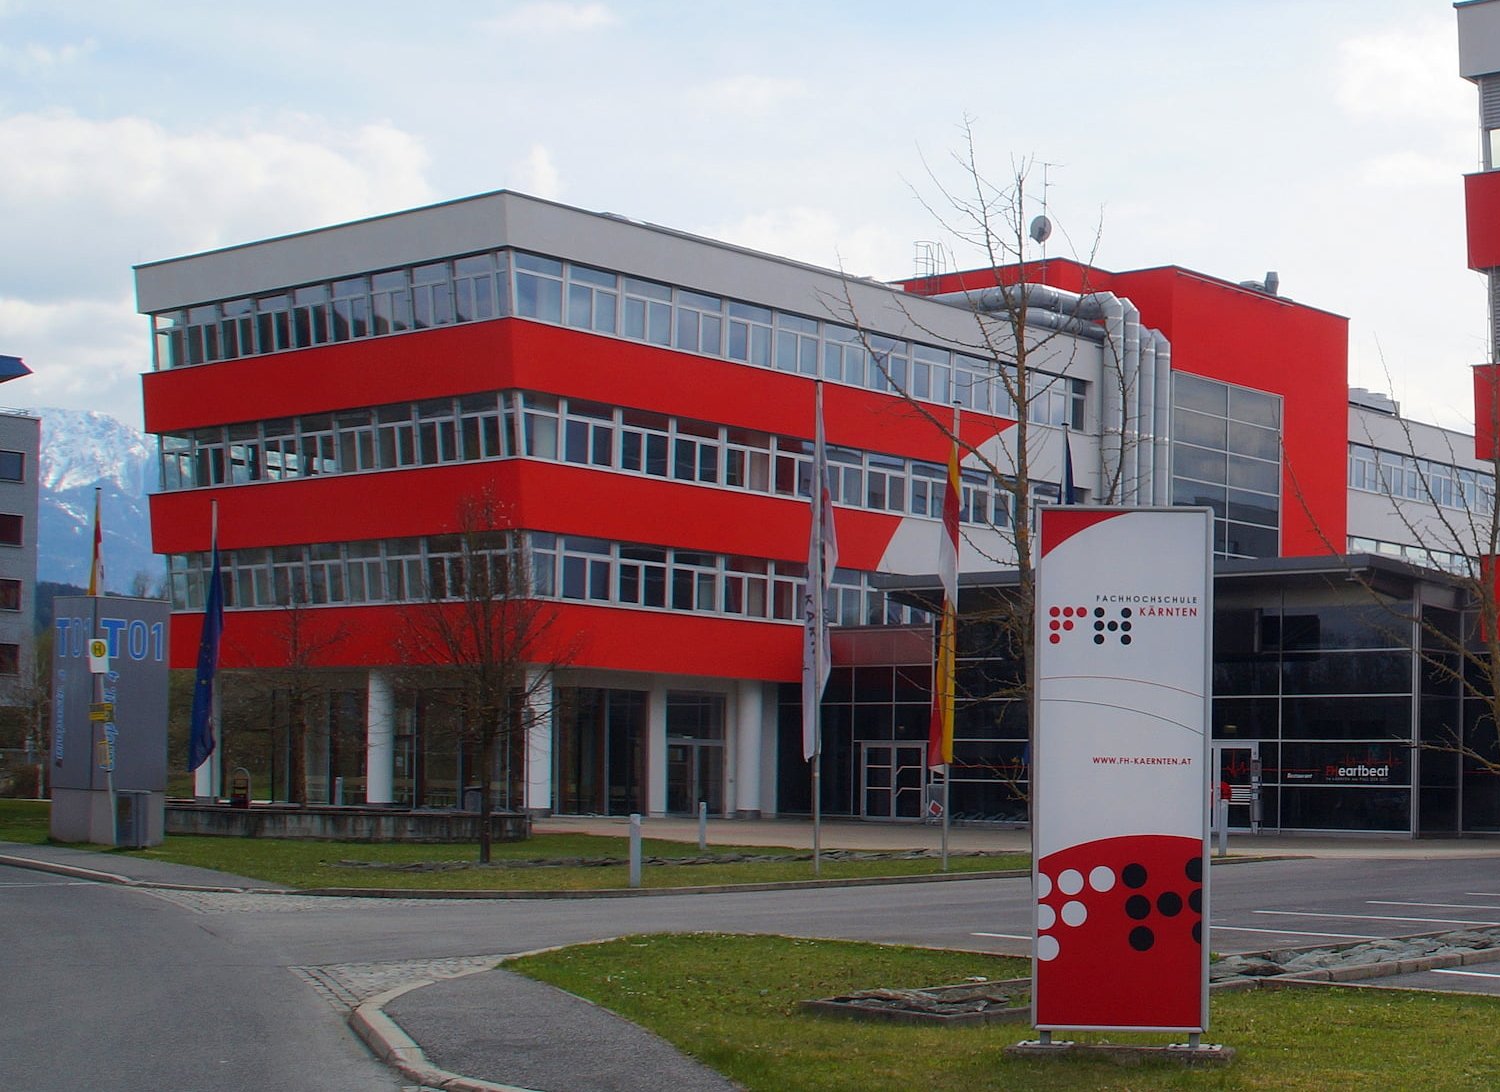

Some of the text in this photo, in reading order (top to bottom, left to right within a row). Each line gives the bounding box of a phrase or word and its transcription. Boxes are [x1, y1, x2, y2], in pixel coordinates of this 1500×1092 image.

[1096, 595, 1198, 604] FACHHOCHSCHULE
[1139, 606, 1198, 617] KÄRNTEN
[100, 617, 163, 662] T01
[1092, 756, 1192, 766] WWW.FH-KAERNTEN.AT
